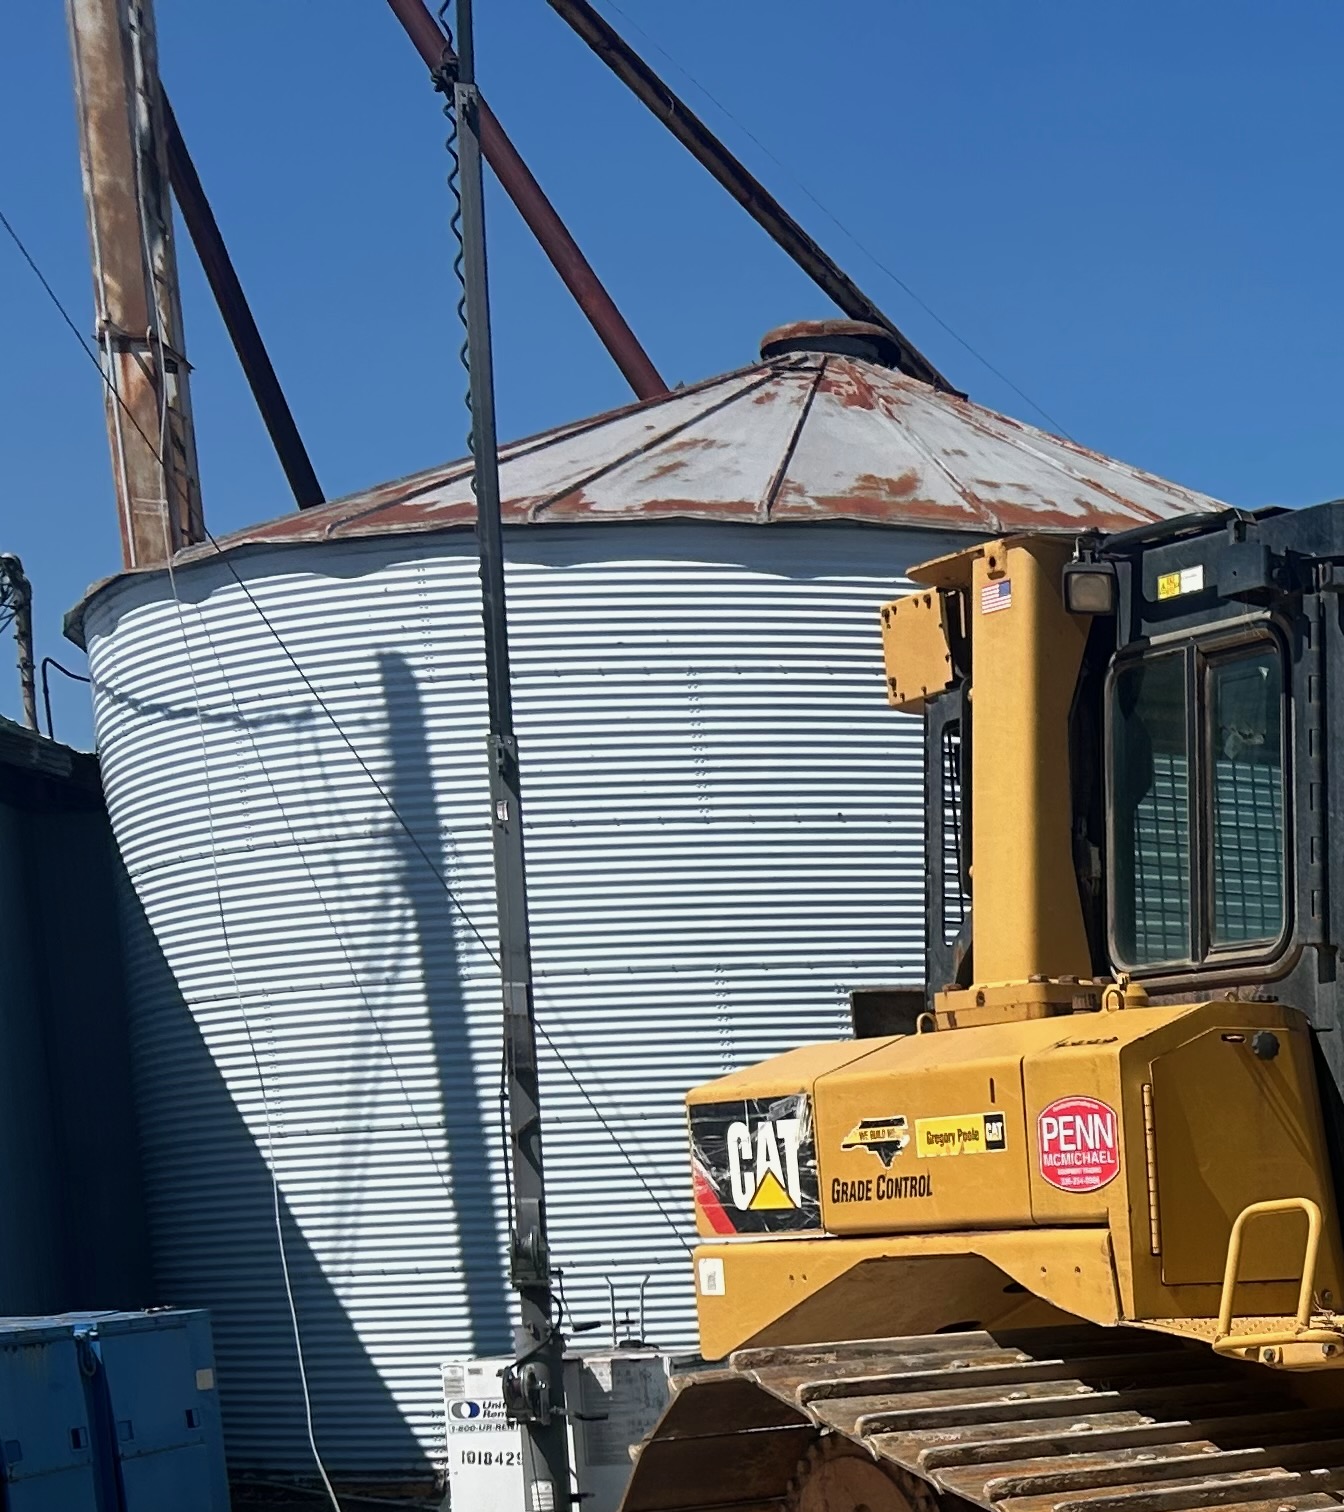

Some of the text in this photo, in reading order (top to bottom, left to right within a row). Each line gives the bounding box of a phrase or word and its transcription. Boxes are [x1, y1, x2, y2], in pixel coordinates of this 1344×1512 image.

[926, 1131, 956, 1147] Gregory
[985, 1122, 1003, 1141] CAT
[1041, 1112, 1114, 1152] PENN
[727, 1119, 802, 1212] CAT
[1043, 1150, 1115, 1167] MCMICHAEL
[832, 1174, 933, 1204] GRADE CONTROL
